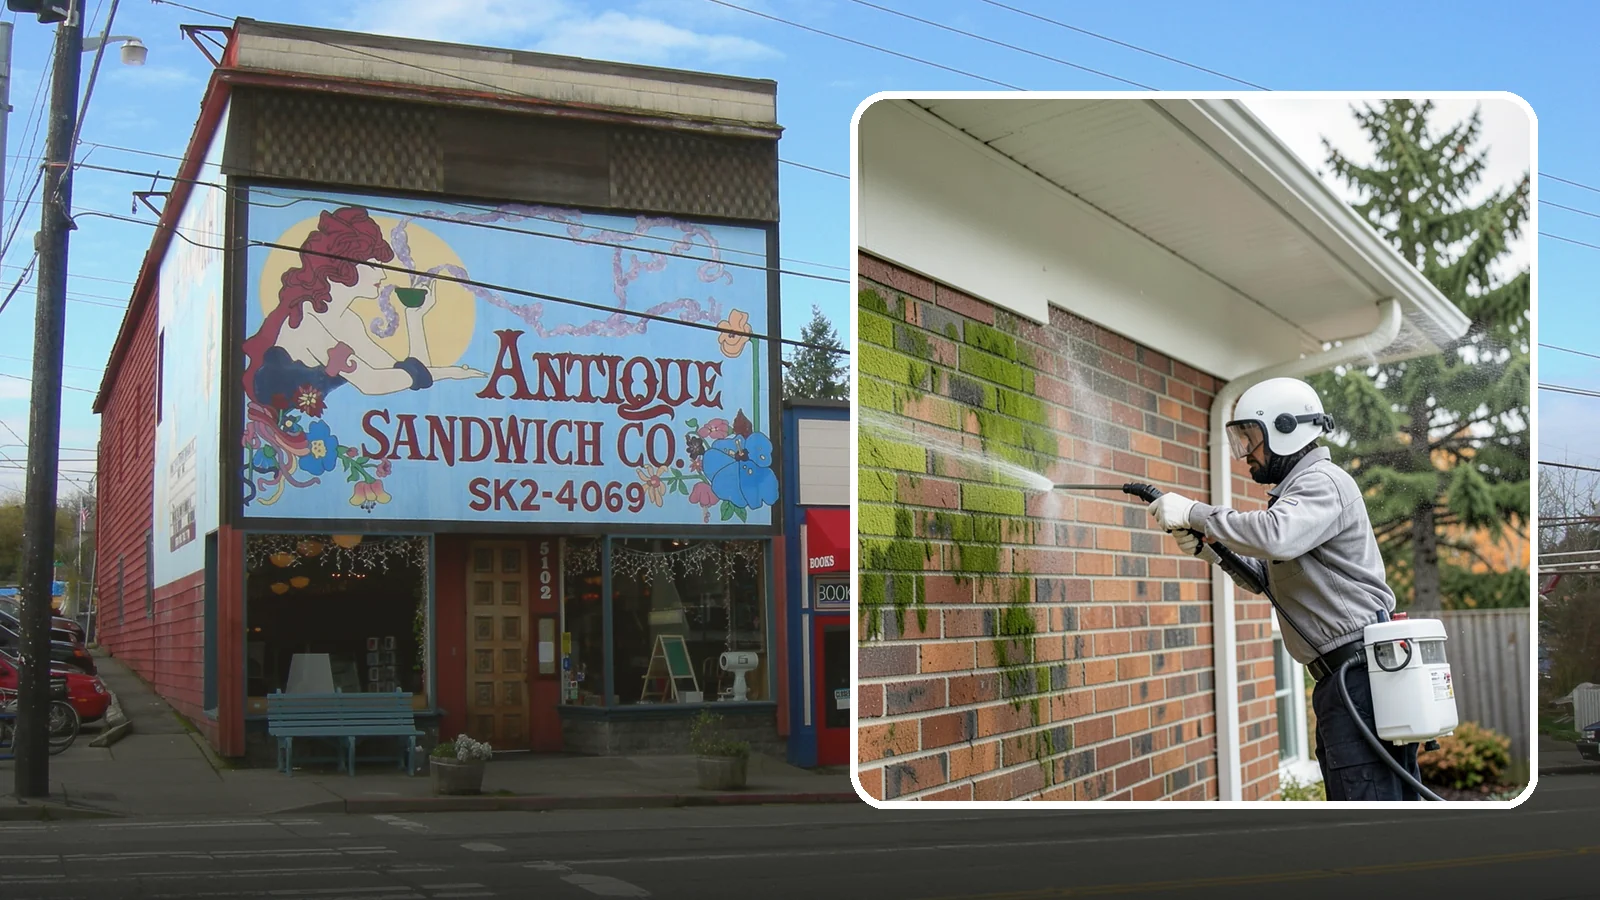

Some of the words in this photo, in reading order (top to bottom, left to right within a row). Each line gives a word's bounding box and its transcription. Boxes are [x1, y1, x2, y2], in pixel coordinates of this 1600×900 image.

[361, 409, 604, 466] SANDWICH
[617, 423, 684, 467] CO.
[469, 477, 645, 512] SK2-4069
[540, 541, 551, 599] 5102
[809, 555, 834, 568] BOOKS
